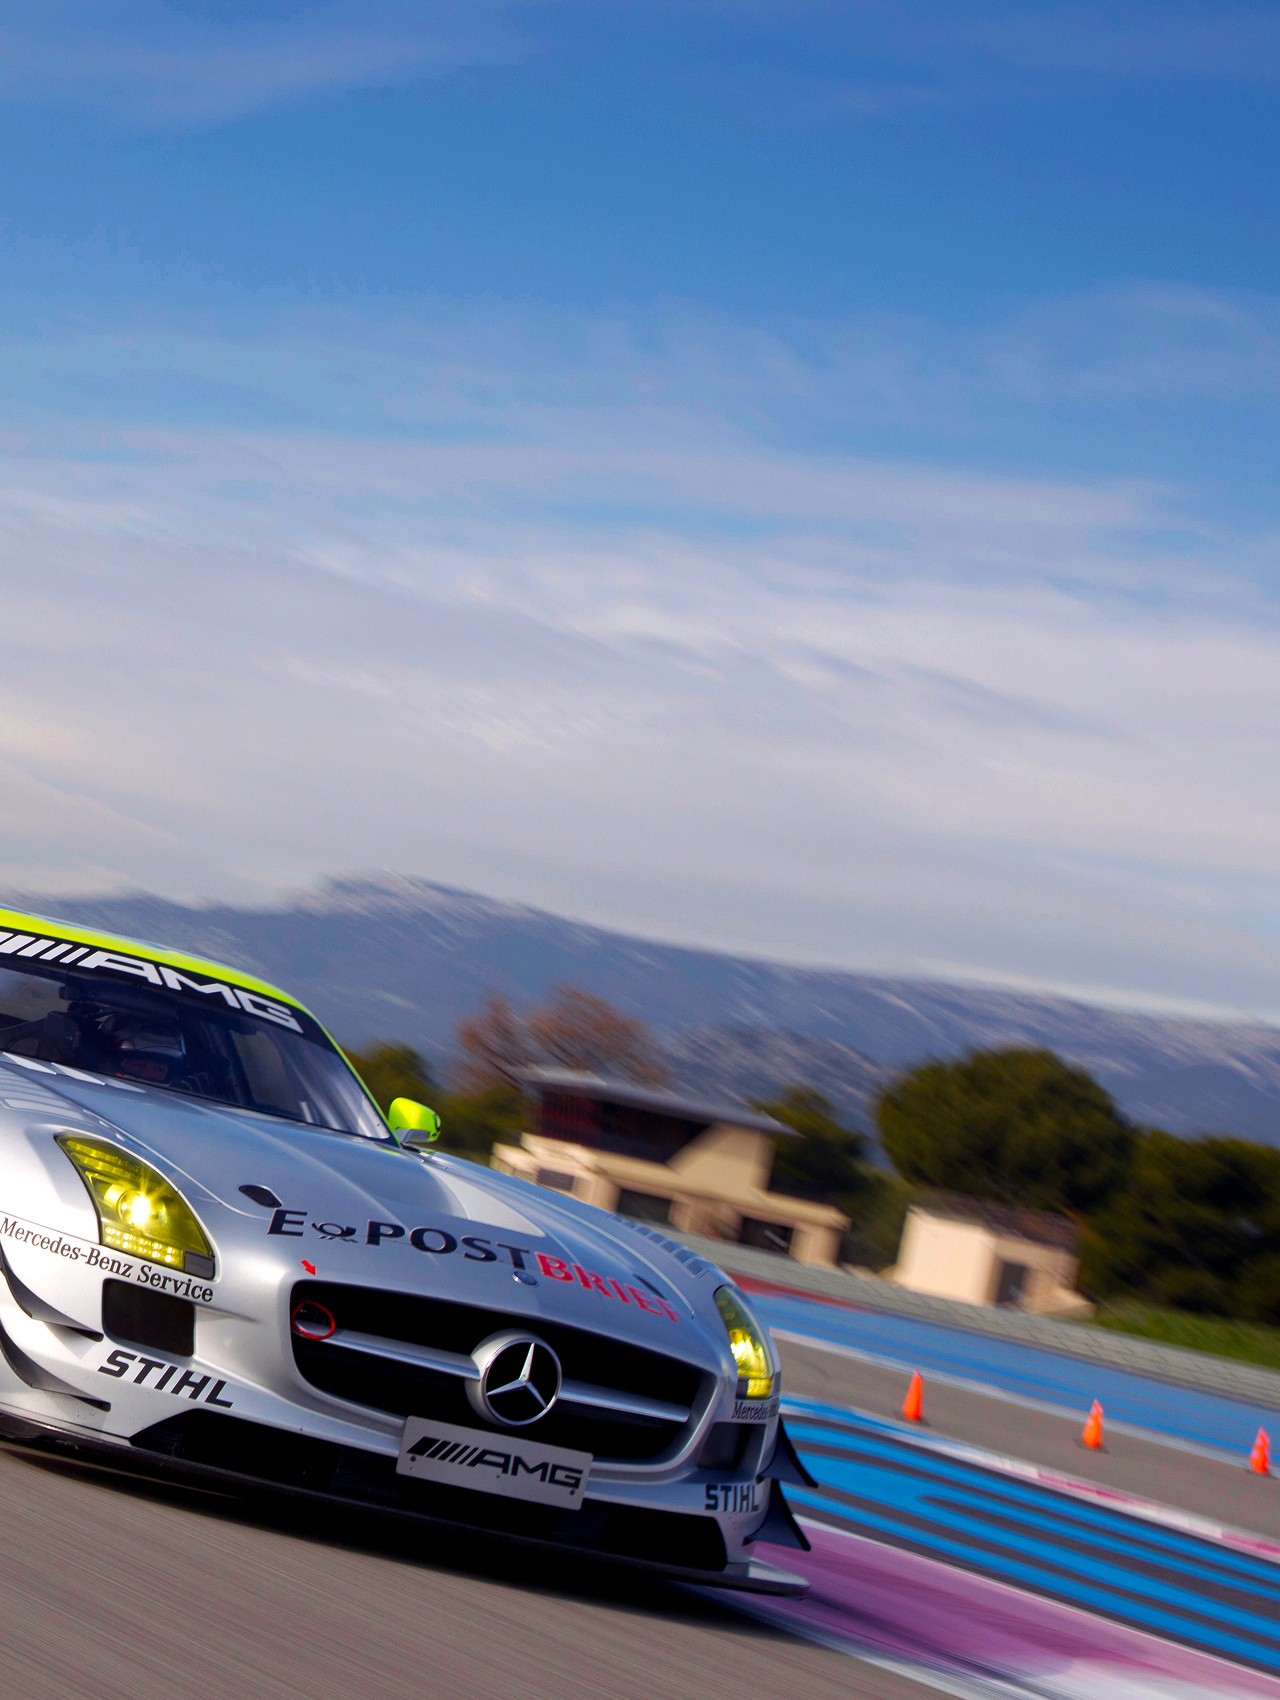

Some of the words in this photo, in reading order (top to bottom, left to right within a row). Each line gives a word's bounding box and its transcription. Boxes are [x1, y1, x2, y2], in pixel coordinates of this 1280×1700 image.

[78, 951, 304, 1035] AMG
[136, 1264, 214, 1302] Service
[97, 1349, 234, 1409] STIHL
[467, 1448, 584, 1489] AMG
[704, 1483, 760, 1513] STIHL
